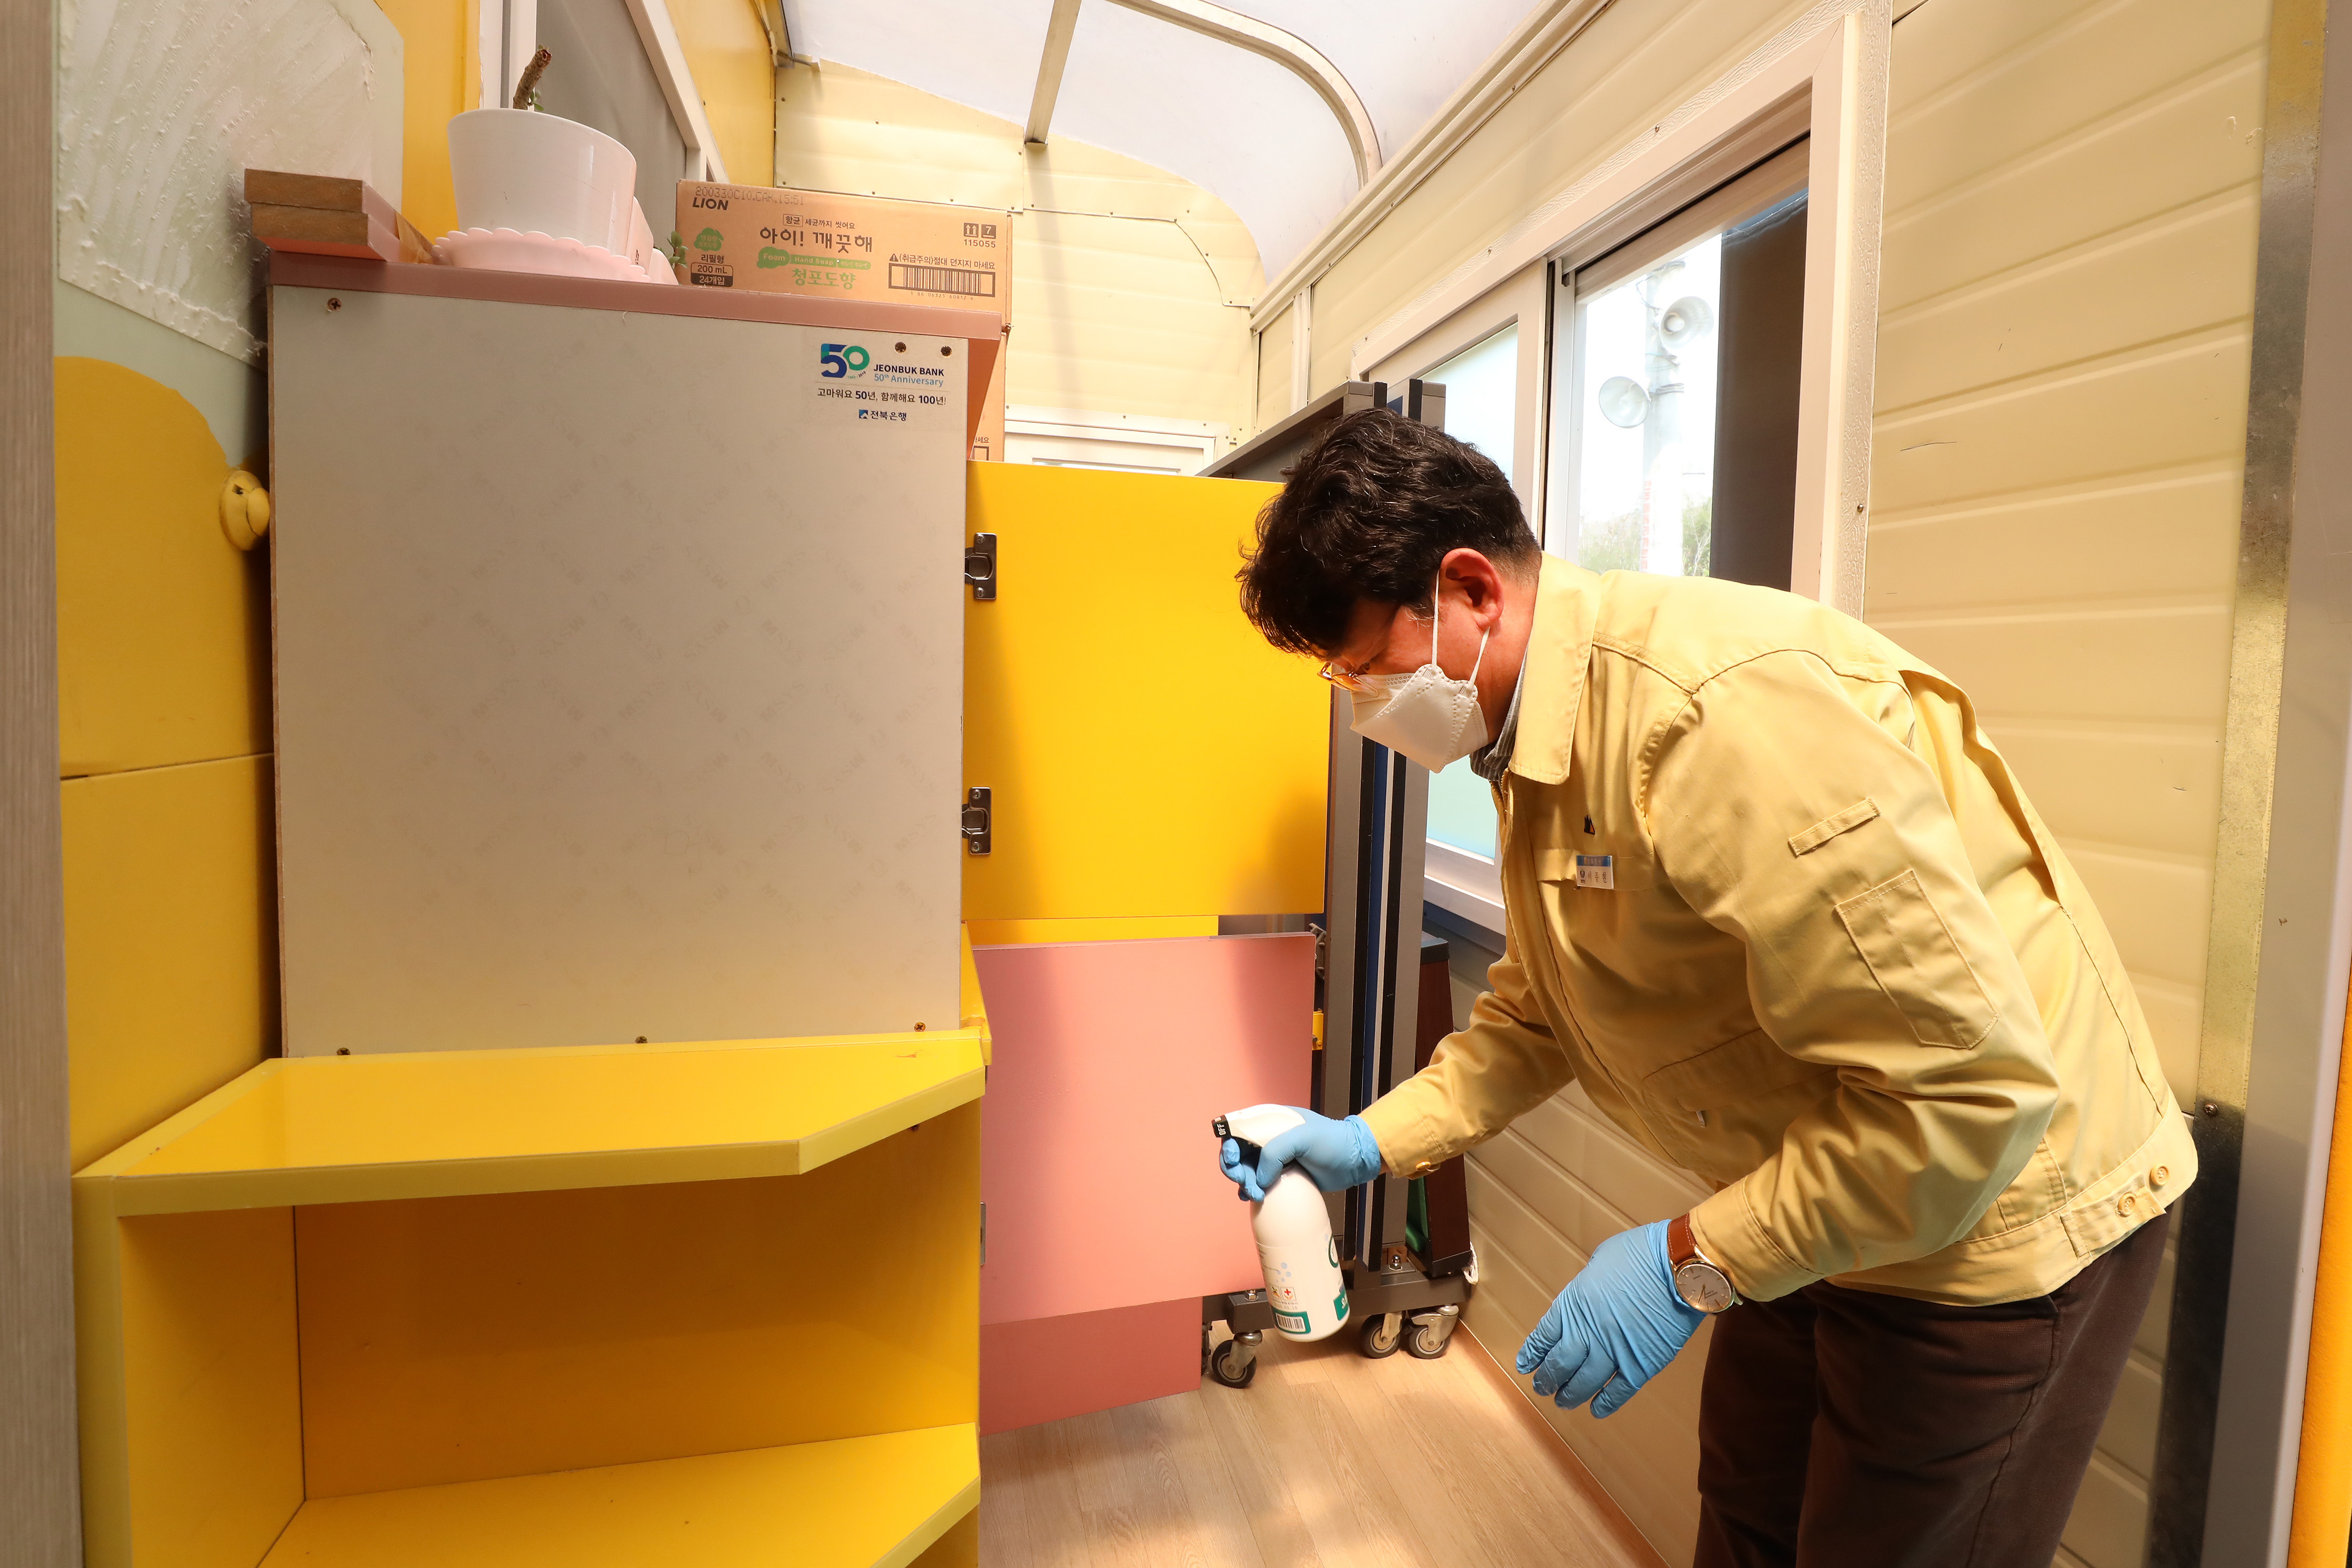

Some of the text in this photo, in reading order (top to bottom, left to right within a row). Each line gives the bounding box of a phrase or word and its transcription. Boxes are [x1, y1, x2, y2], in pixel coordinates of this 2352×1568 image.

[692, 197, 729, 211] LION
[786, 216, 801, 225] 항균
[805, 219, 855, 229] 세균까지 씻어요
[985, 226, 992, 235] 7
[760, 227, 872, 254] 아이! 깨끗해
[964, 239, 996, 248] 115055
[701, 254, 724, 264] 리필형
[950, 258, 971, 268] 던지지
[974, 261, 996, 270] 마세요
[697, 265, 713, 273] 200
[699, 275, 725, 285] 24개입
[792, 268, 857, 290] 청포도향
[821, 343, 870, 378] 50
[873, 364, 945, 377] JEONBUK BANK
[891, 375, 943, 388] Anniversary
[817, 388, 946, 405] 고마워요 50년, 함께해요 100년!
[870, 410, 907, 422] 전북은행
[1217, 1123, 1226, 1136] OFF
